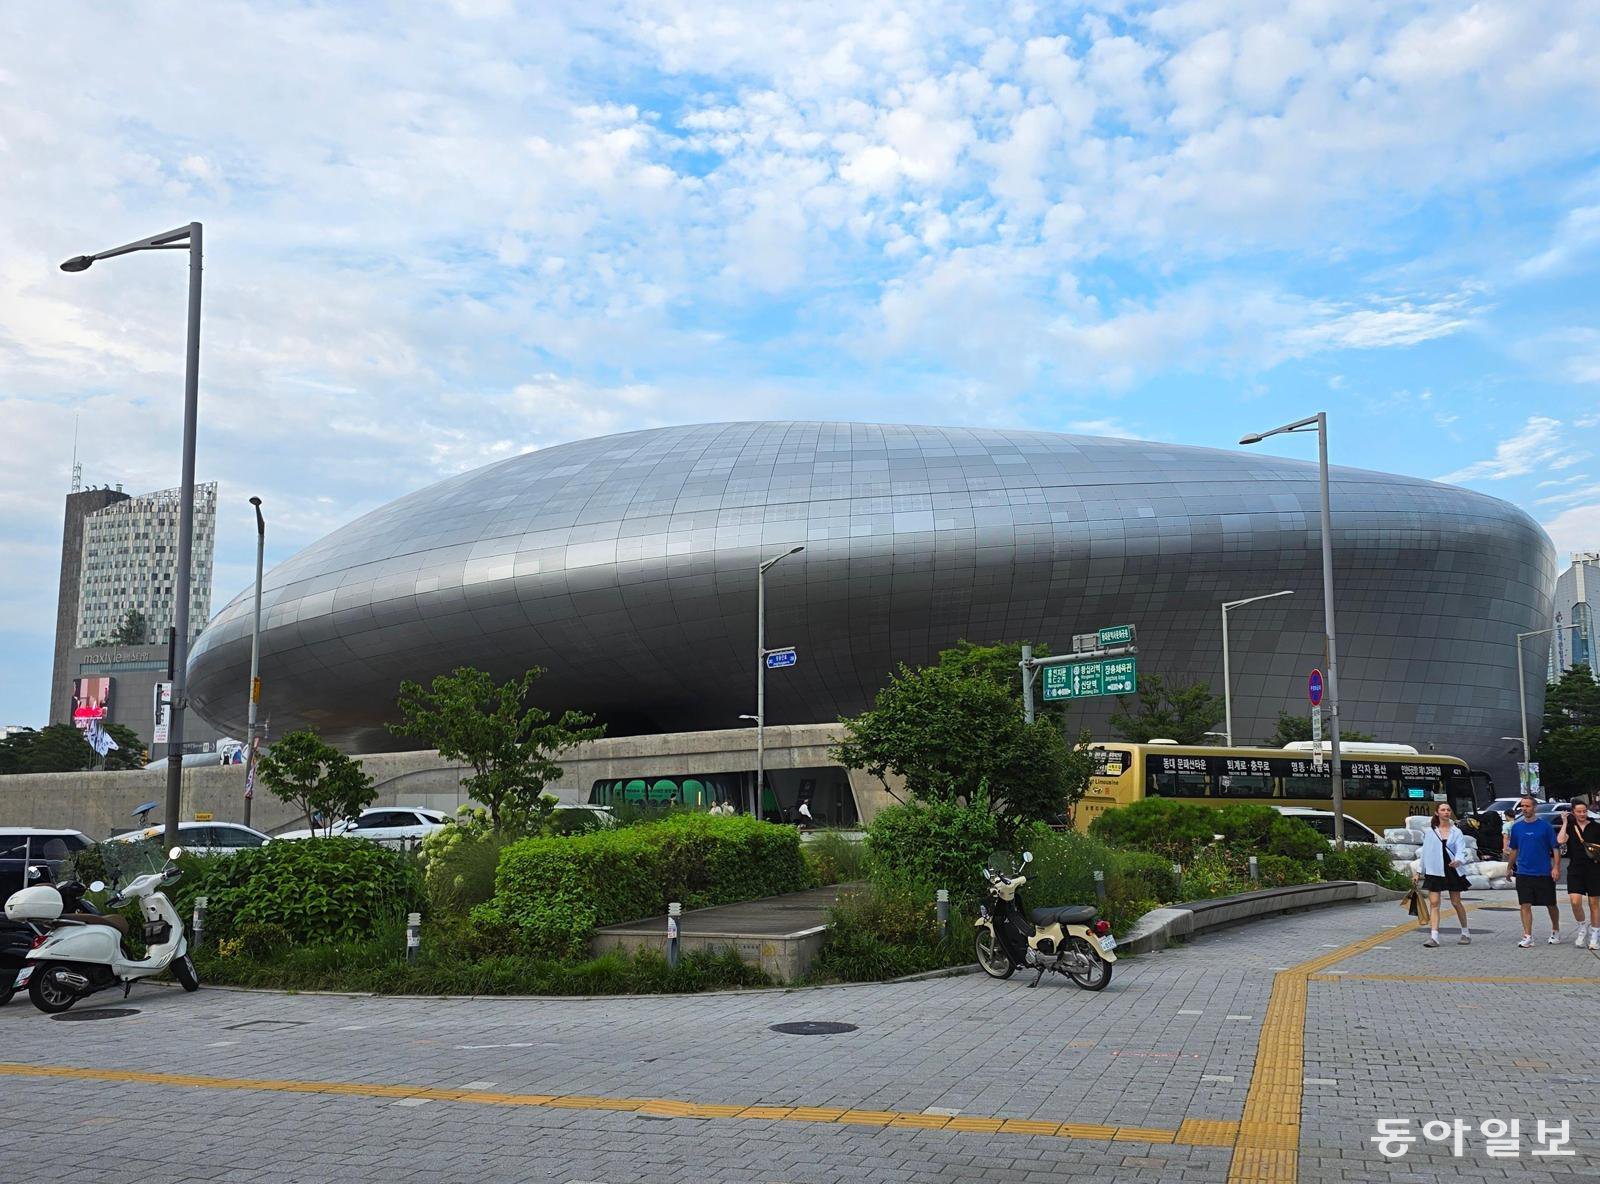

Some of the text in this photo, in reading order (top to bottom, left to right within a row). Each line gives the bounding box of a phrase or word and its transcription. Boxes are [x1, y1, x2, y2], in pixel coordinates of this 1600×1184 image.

[1081, 664, 1100, 675] 왕십리역
[1105, 662, 1132, 675] 장충체육관
[1081, 679, 1097, 690] 신당역
